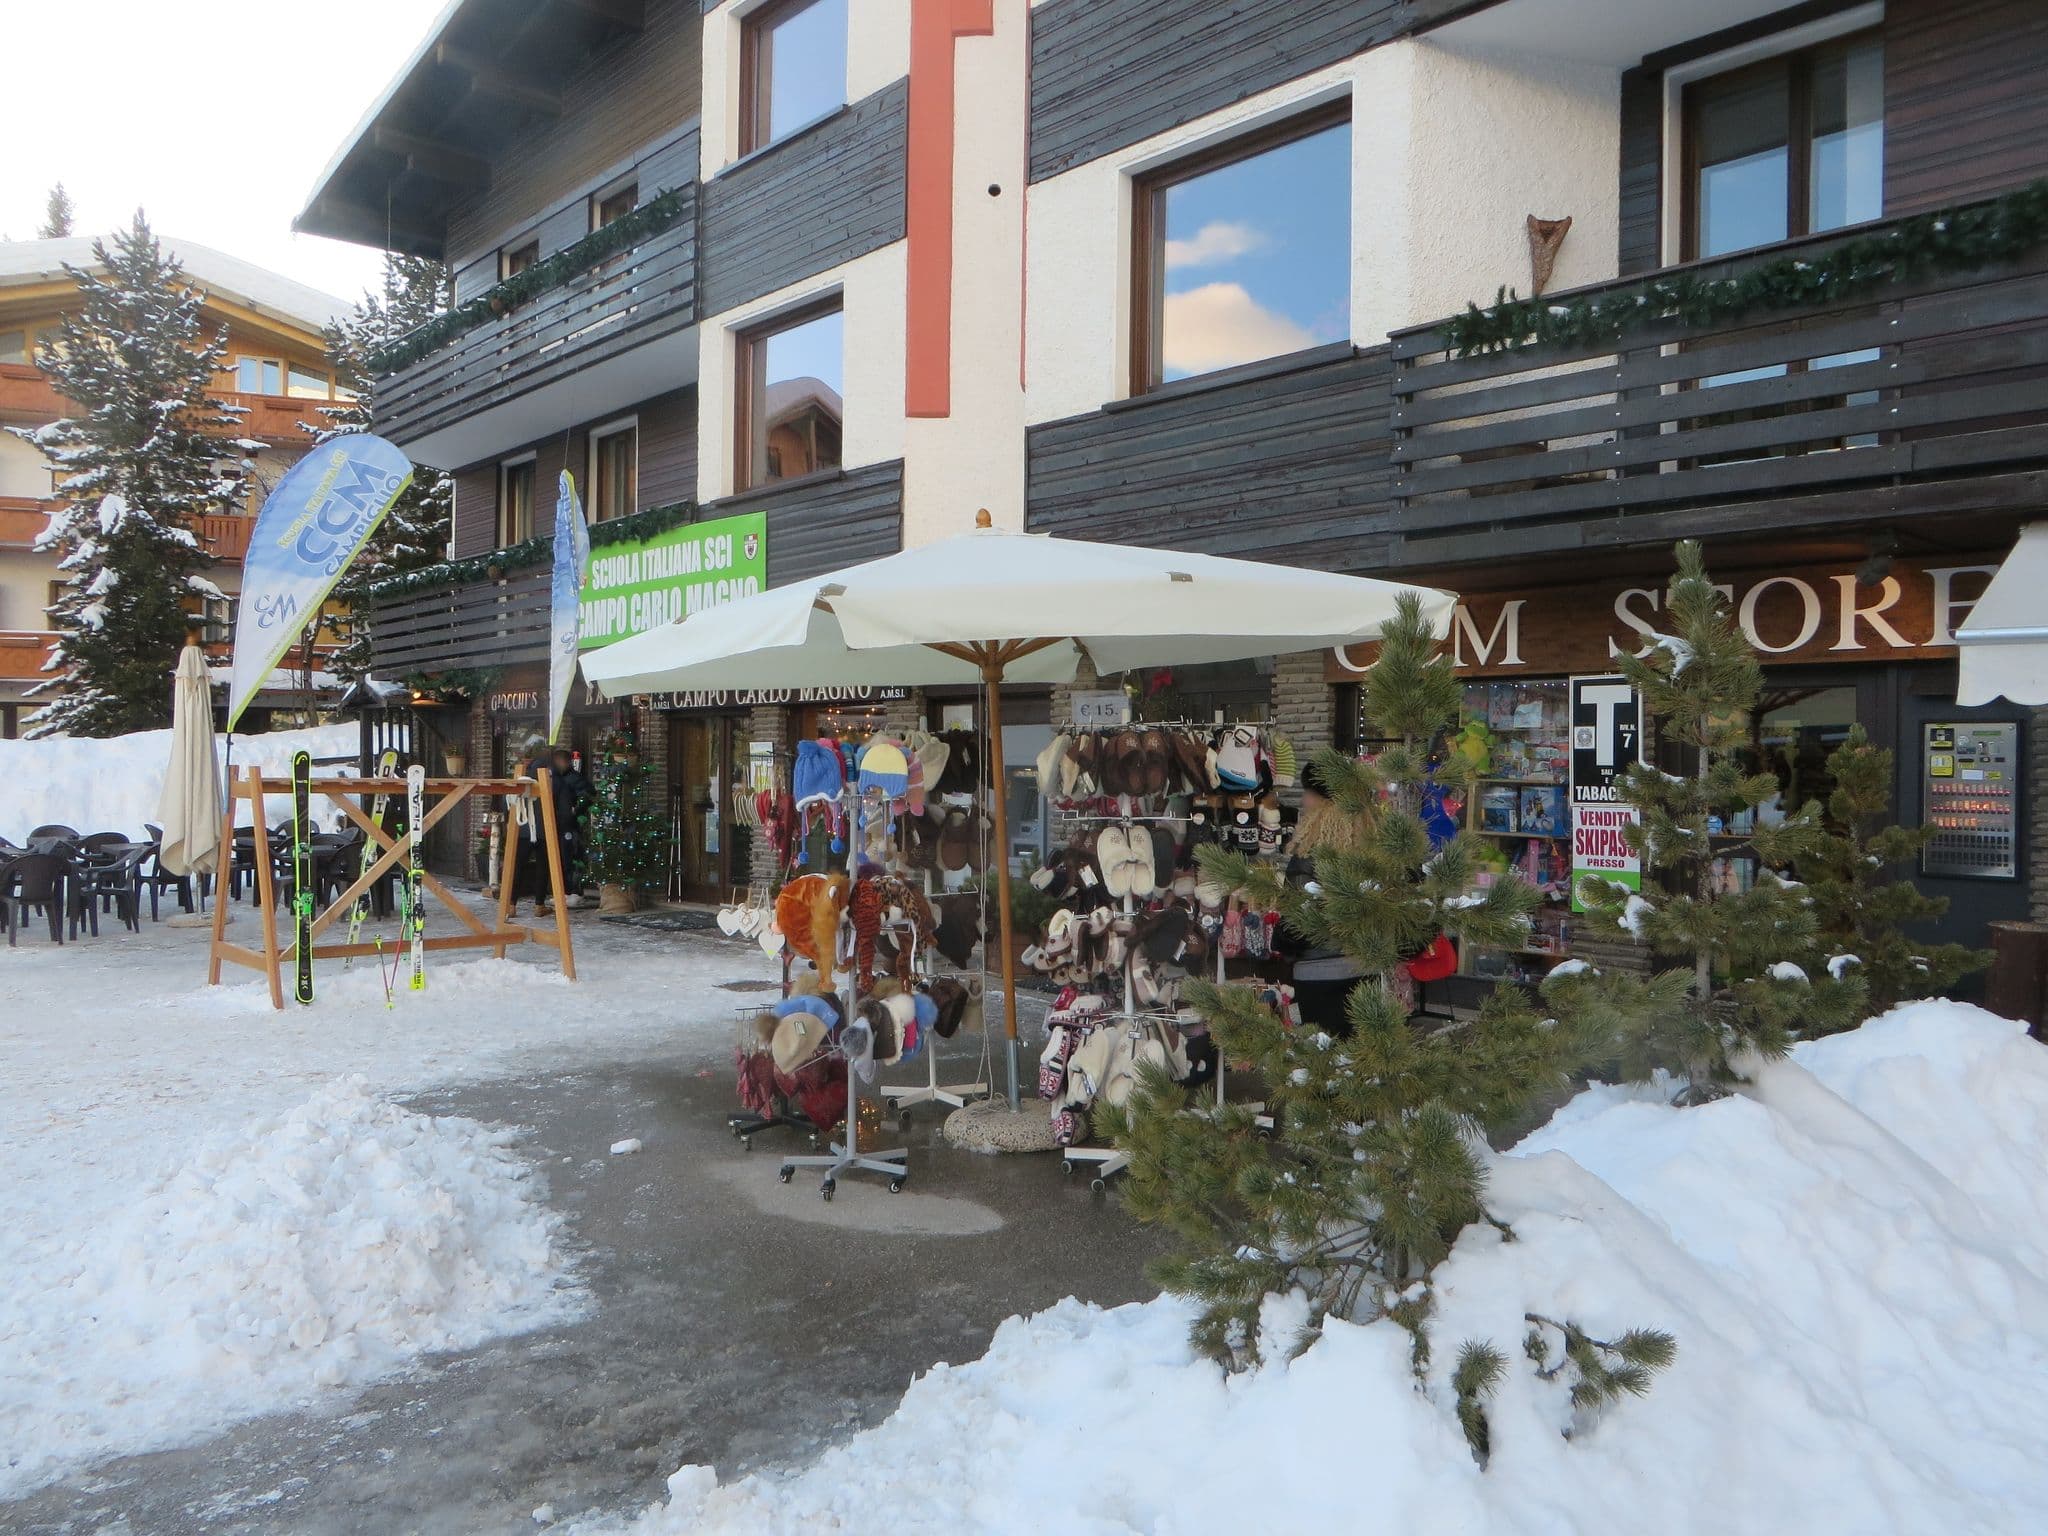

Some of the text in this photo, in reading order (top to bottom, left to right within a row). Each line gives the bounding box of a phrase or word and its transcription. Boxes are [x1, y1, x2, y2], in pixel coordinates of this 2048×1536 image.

[296, 459, 388, 564] CCM
[324, 474, 402, 577] CAMPIGLIO
[592, 534, 733, 590] SCUOLA ITALIANA SCI
[578, 596, 627, 639] CAMPO
[630, 587, 682, 633] CARLO
[1608, 565, 2000, 660] SORE
[673, 686, 872, 708] CAMPO CARLO MAGNO
[1081, 704, 1090, 716] €
[1581, 686, 1632, 766] T
[1623, 733, 1632, 748] 7
[1579, 810, 1632, 827] VENDITA
[1587, 858, 1625, 868] PRESSO
